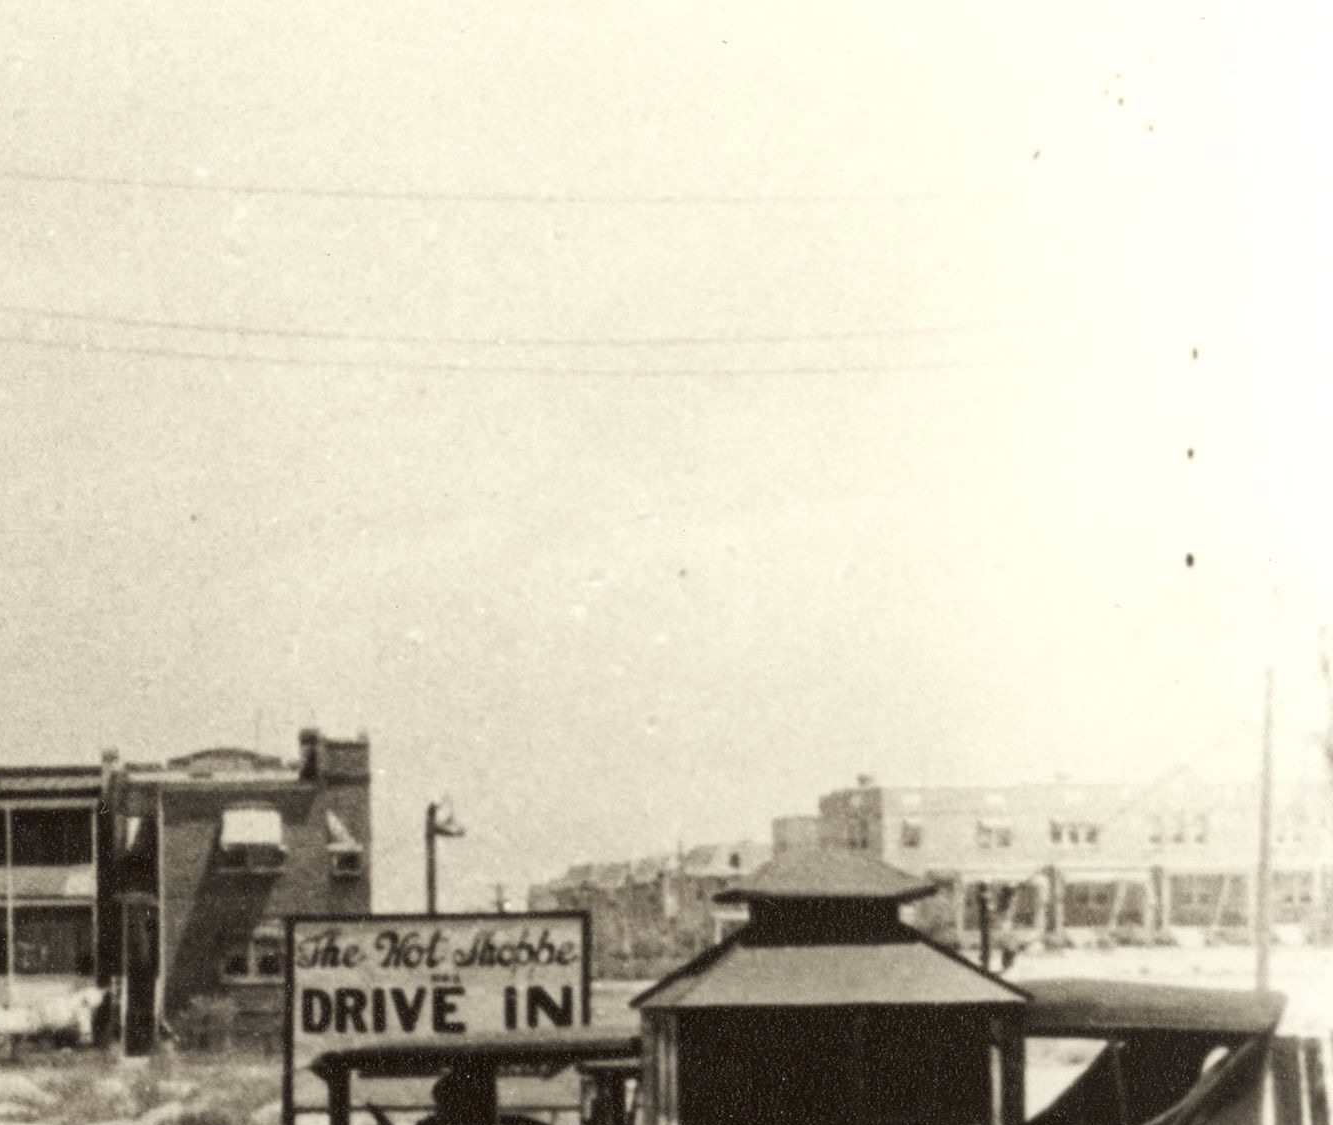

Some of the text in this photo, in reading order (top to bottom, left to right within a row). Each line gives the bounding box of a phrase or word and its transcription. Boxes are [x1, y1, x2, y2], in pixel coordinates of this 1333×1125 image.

[297, 930, 366, 969] The
[375, 930, 450, 969] Hot
[301, 984, 573, 1034] DRIVE IN
